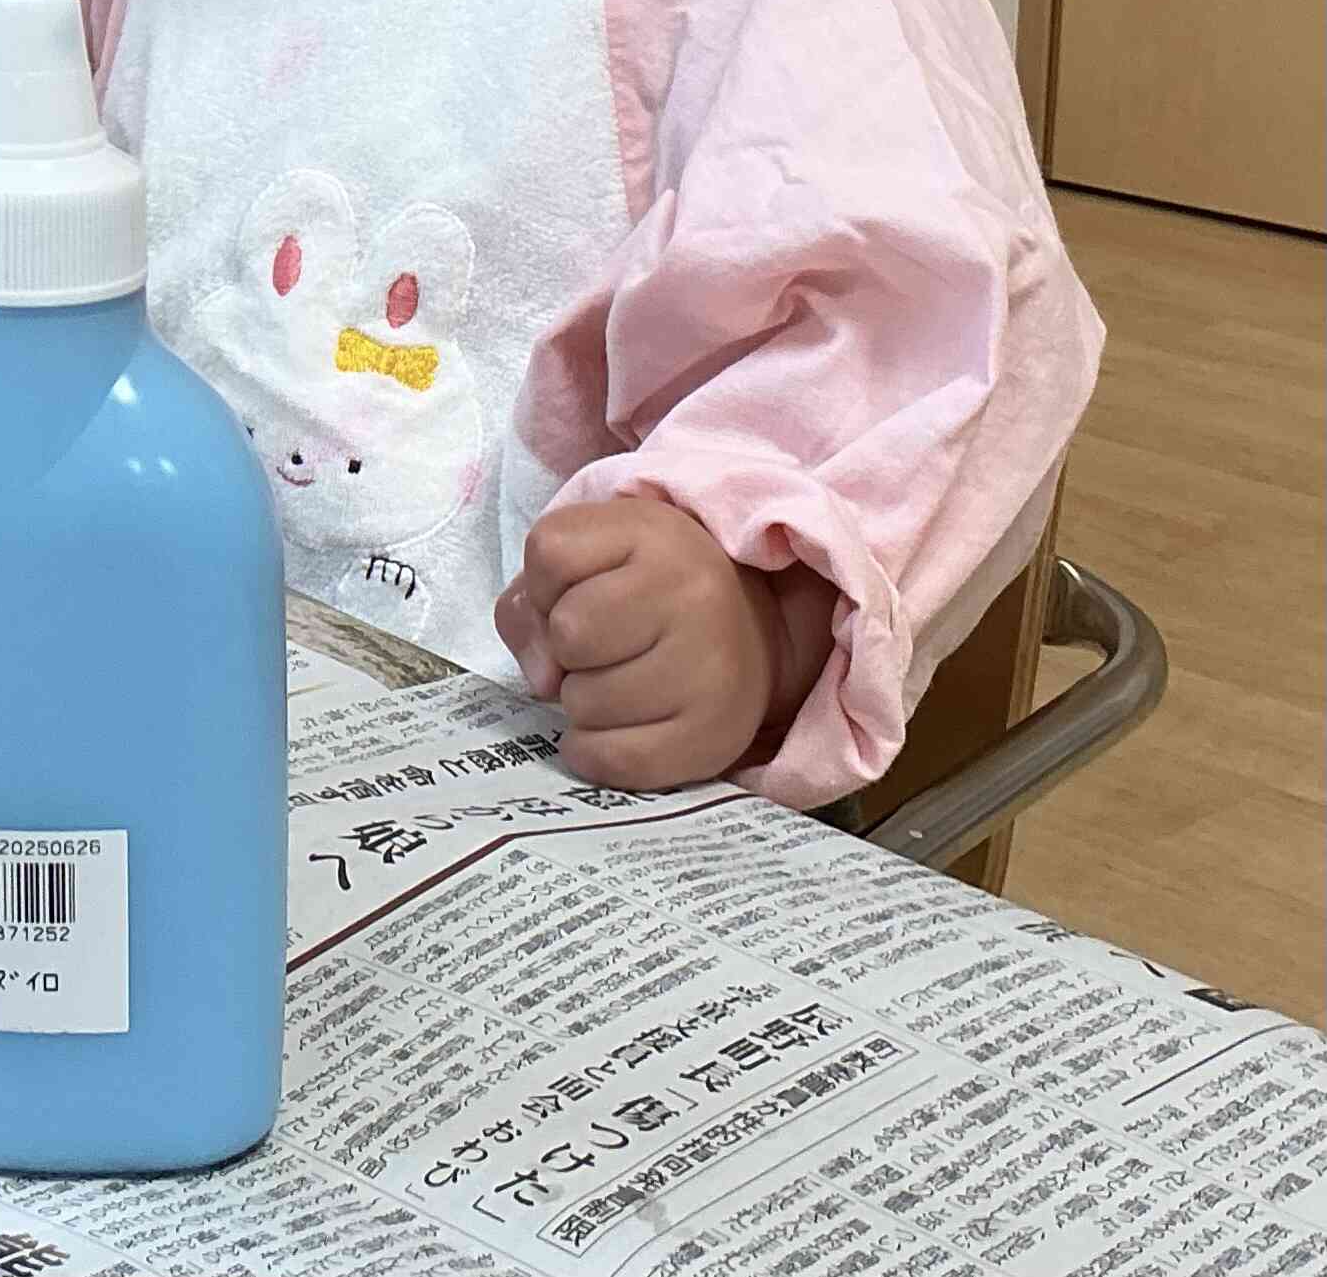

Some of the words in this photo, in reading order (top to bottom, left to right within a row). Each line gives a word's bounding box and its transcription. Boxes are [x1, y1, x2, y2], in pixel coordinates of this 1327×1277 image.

[472, 1002, 853, 1224] 辰野町長「傷つけた」
